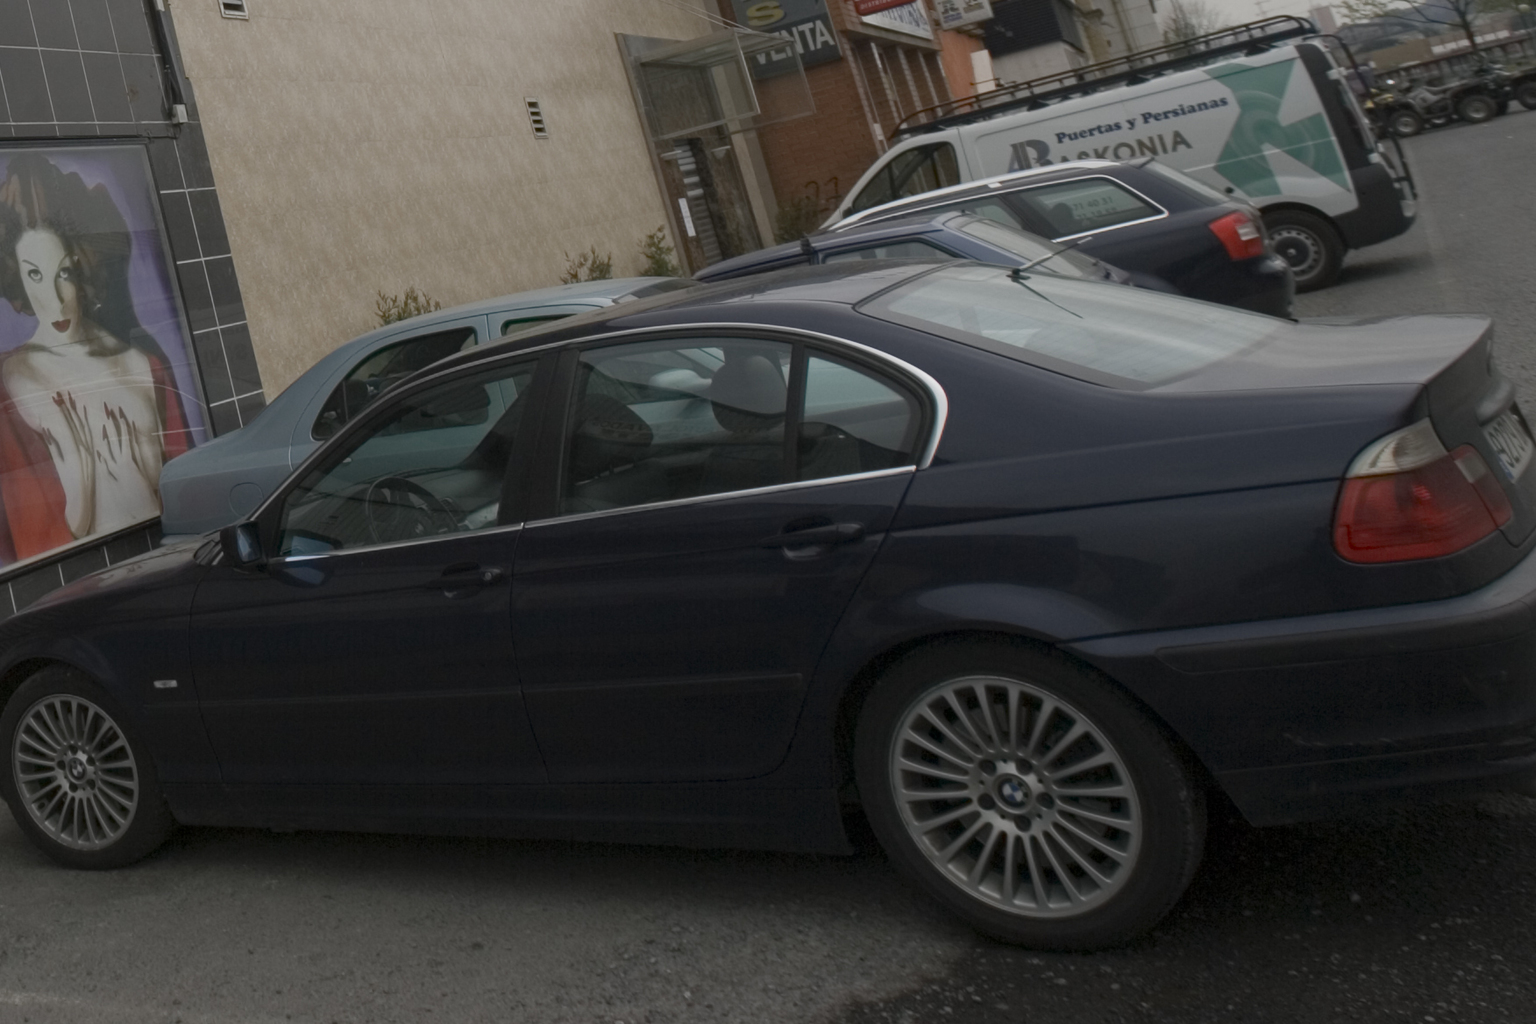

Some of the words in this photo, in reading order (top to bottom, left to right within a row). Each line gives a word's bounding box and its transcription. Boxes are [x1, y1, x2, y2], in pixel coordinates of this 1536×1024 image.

[1055, 121, 1122, 144] Puertas
[1125, 117, 1137, 130] y
[1140, 97, 1229, 124] Persianas
